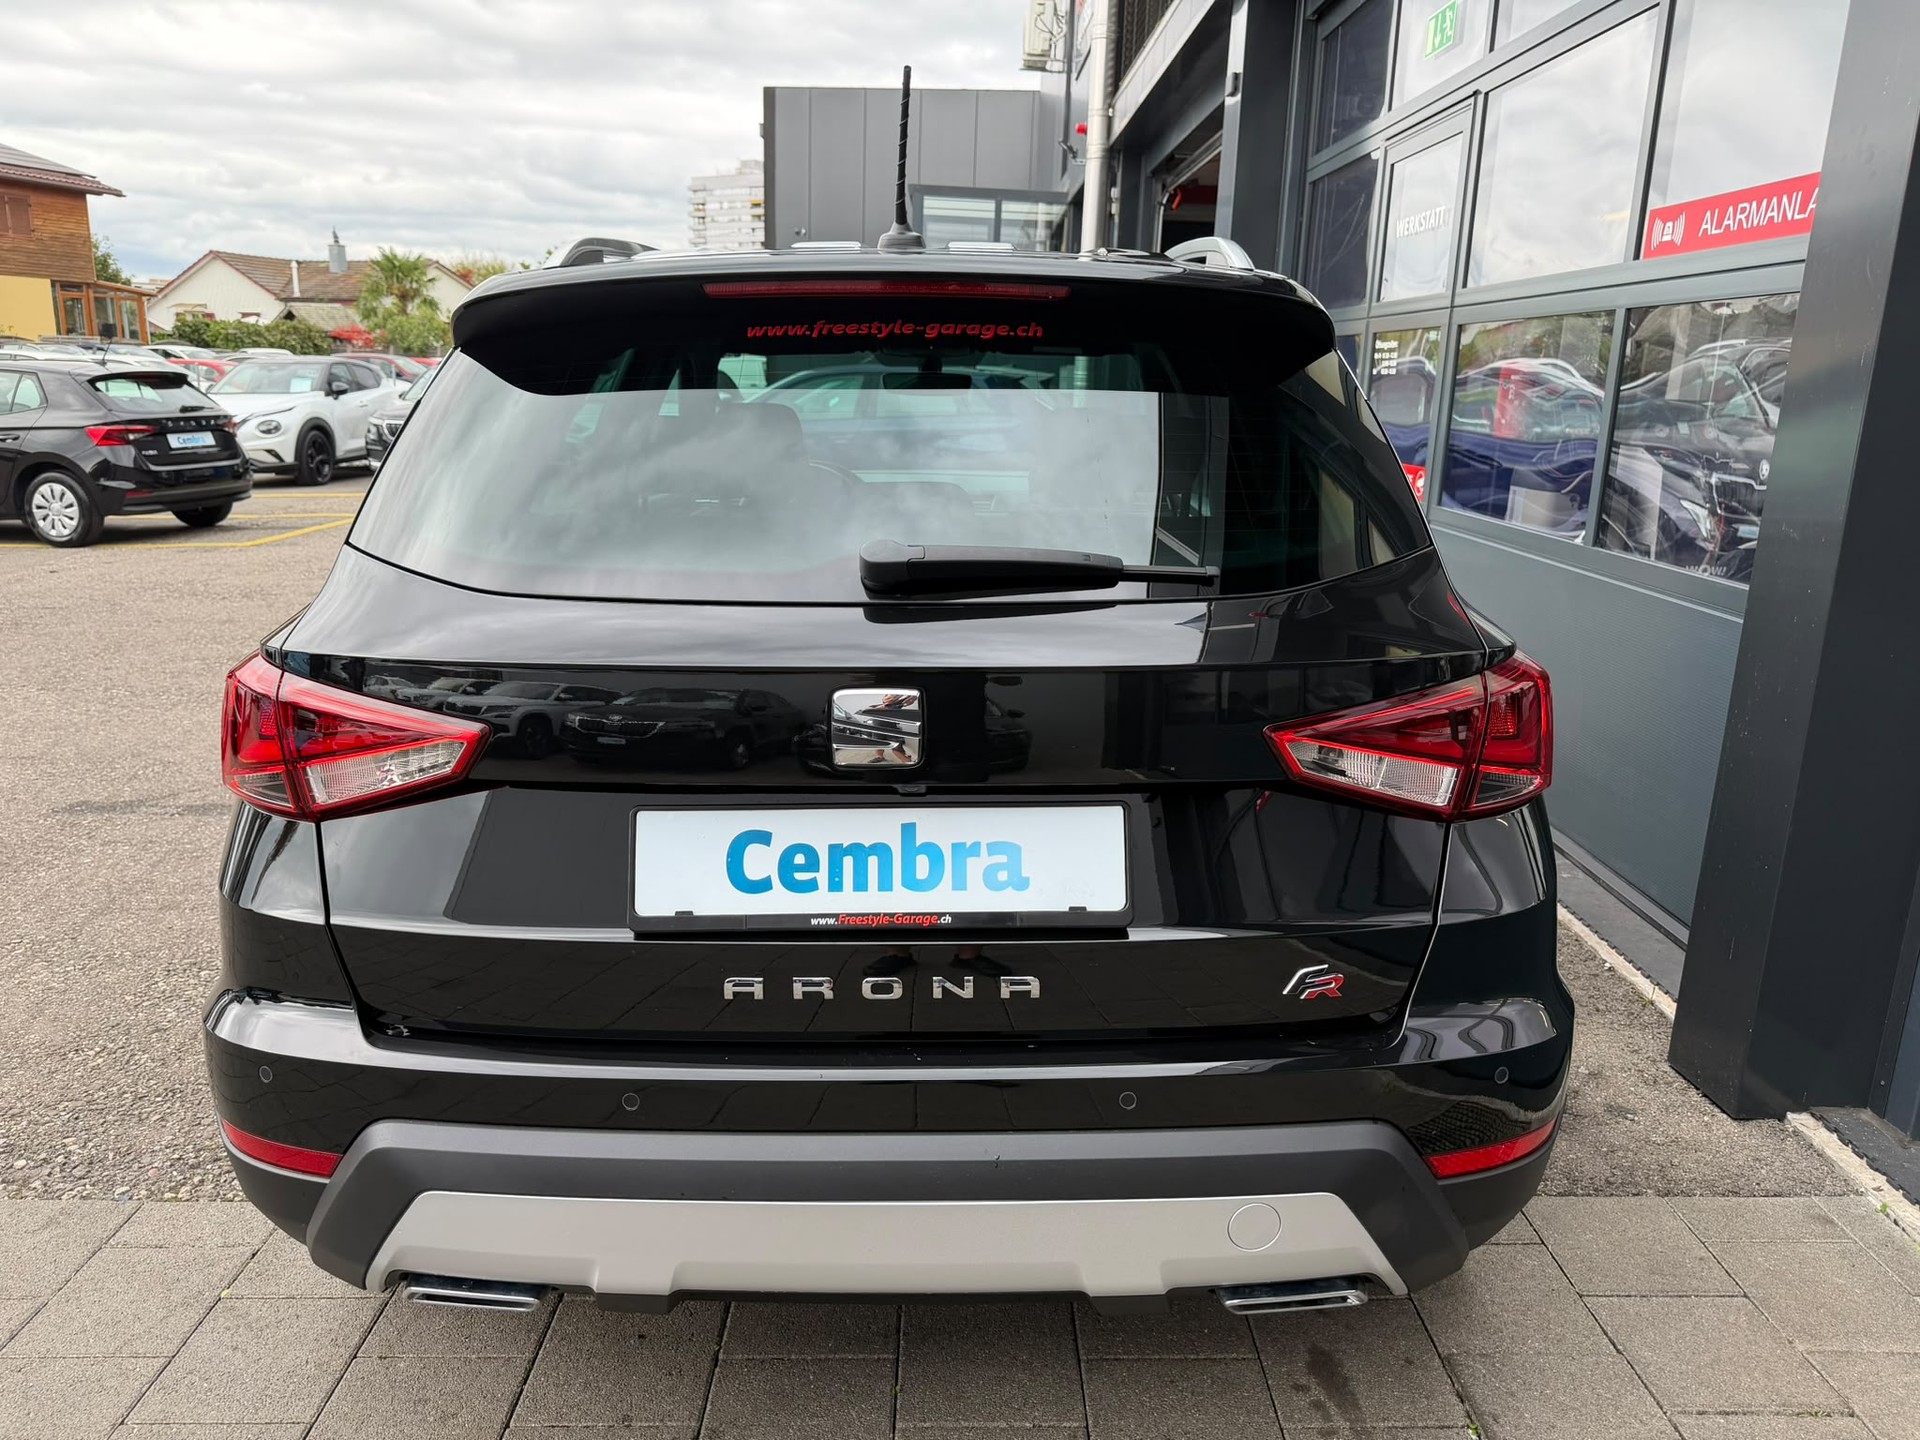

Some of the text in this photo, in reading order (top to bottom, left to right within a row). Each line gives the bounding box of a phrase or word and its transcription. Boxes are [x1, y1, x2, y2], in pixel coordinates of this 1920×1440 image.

[747, 319, 1043, 339] www.freestyle-garage.ch
[725, 821, 1031, 895] Cembra
[810, 913, 952, 928] www.Freestyle-Garage.ch
[723, 976, 1041, 1000] ARONA
[1282, 964, 1344, 1000] FR
